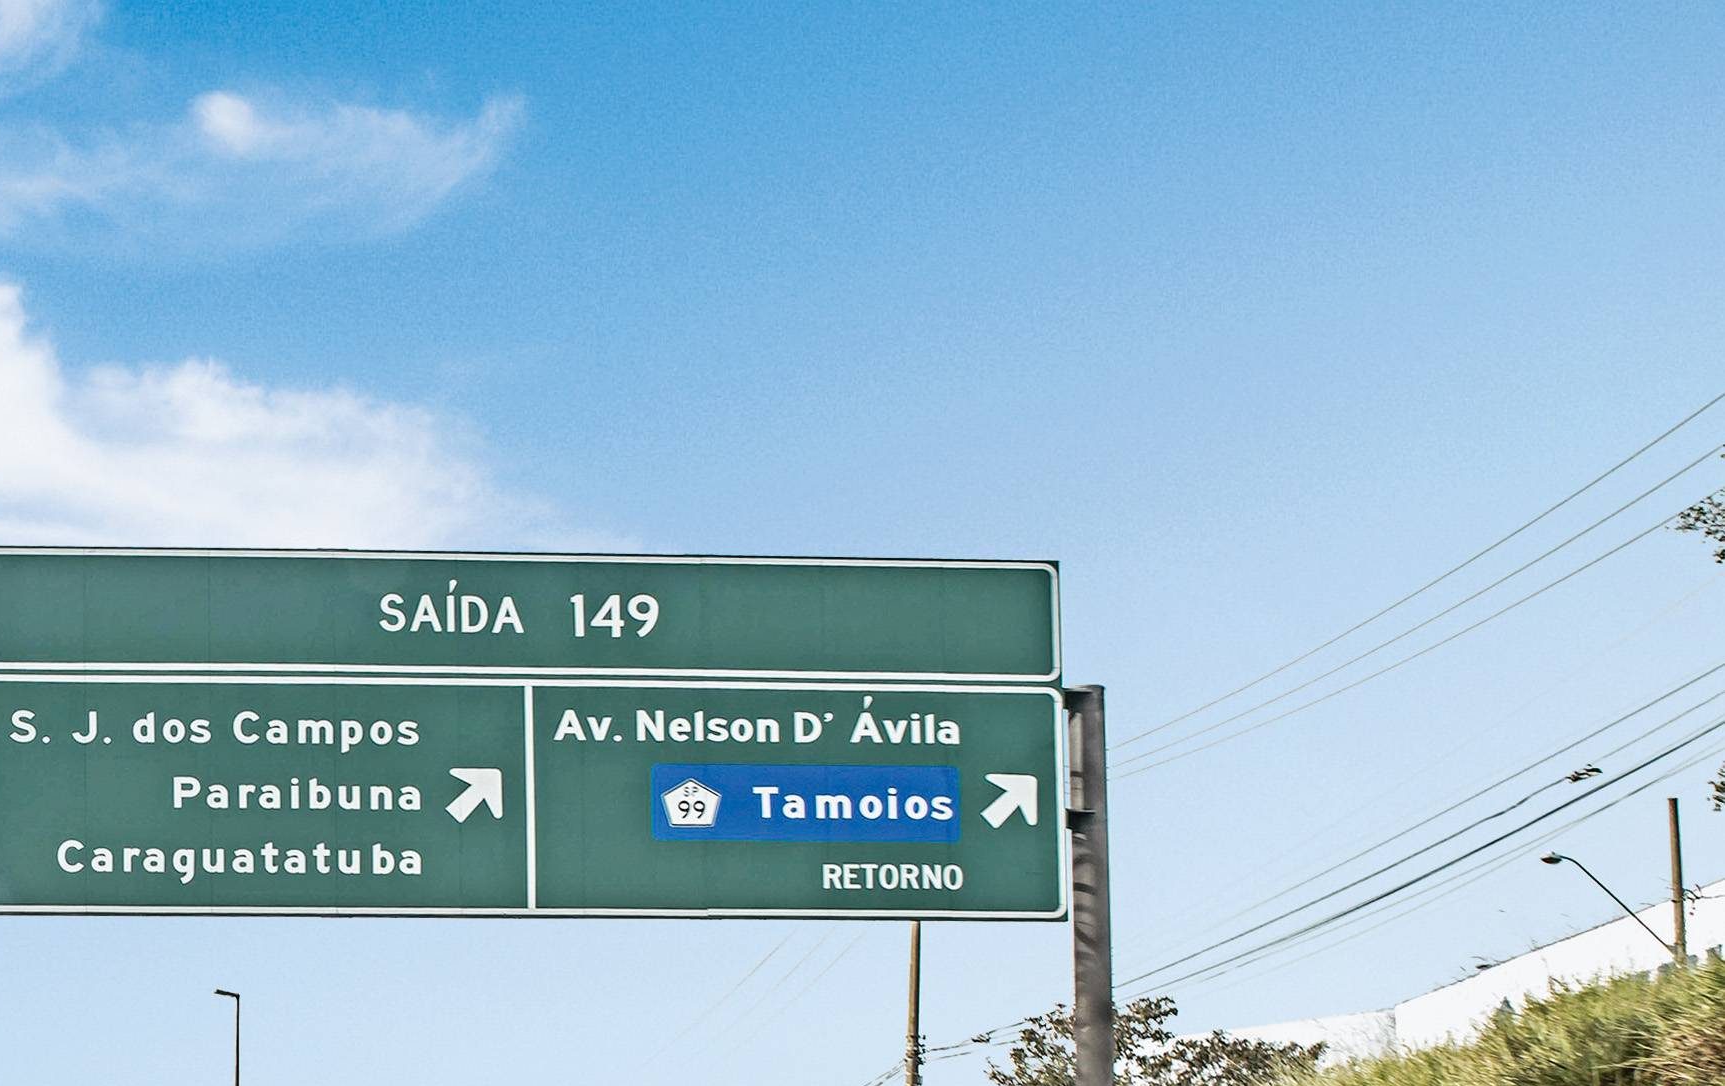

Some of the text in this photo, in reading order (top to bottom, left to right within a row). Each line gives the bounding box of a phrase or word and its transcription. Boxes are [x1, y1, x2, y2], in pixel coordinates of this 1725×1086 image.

[379, 579, 660, 638] SAÍDA 149
[9, 709, 420, 754] S. J. dos Campos
[553, 709, 623, 742] Av.
[636, 709, 780, 743] Nelson
[850, 695, 960, 745] Ávila
[173, 776, 421, 811] Paraibuna
[683, 785, 699, 798] SP
[752, 786, 953, 820] Tamoios
[677, 800, 706, 820] 99
[57, 839, 422, 884] Caraguatatuba
[822, 863, 964, 891] RETORNO
